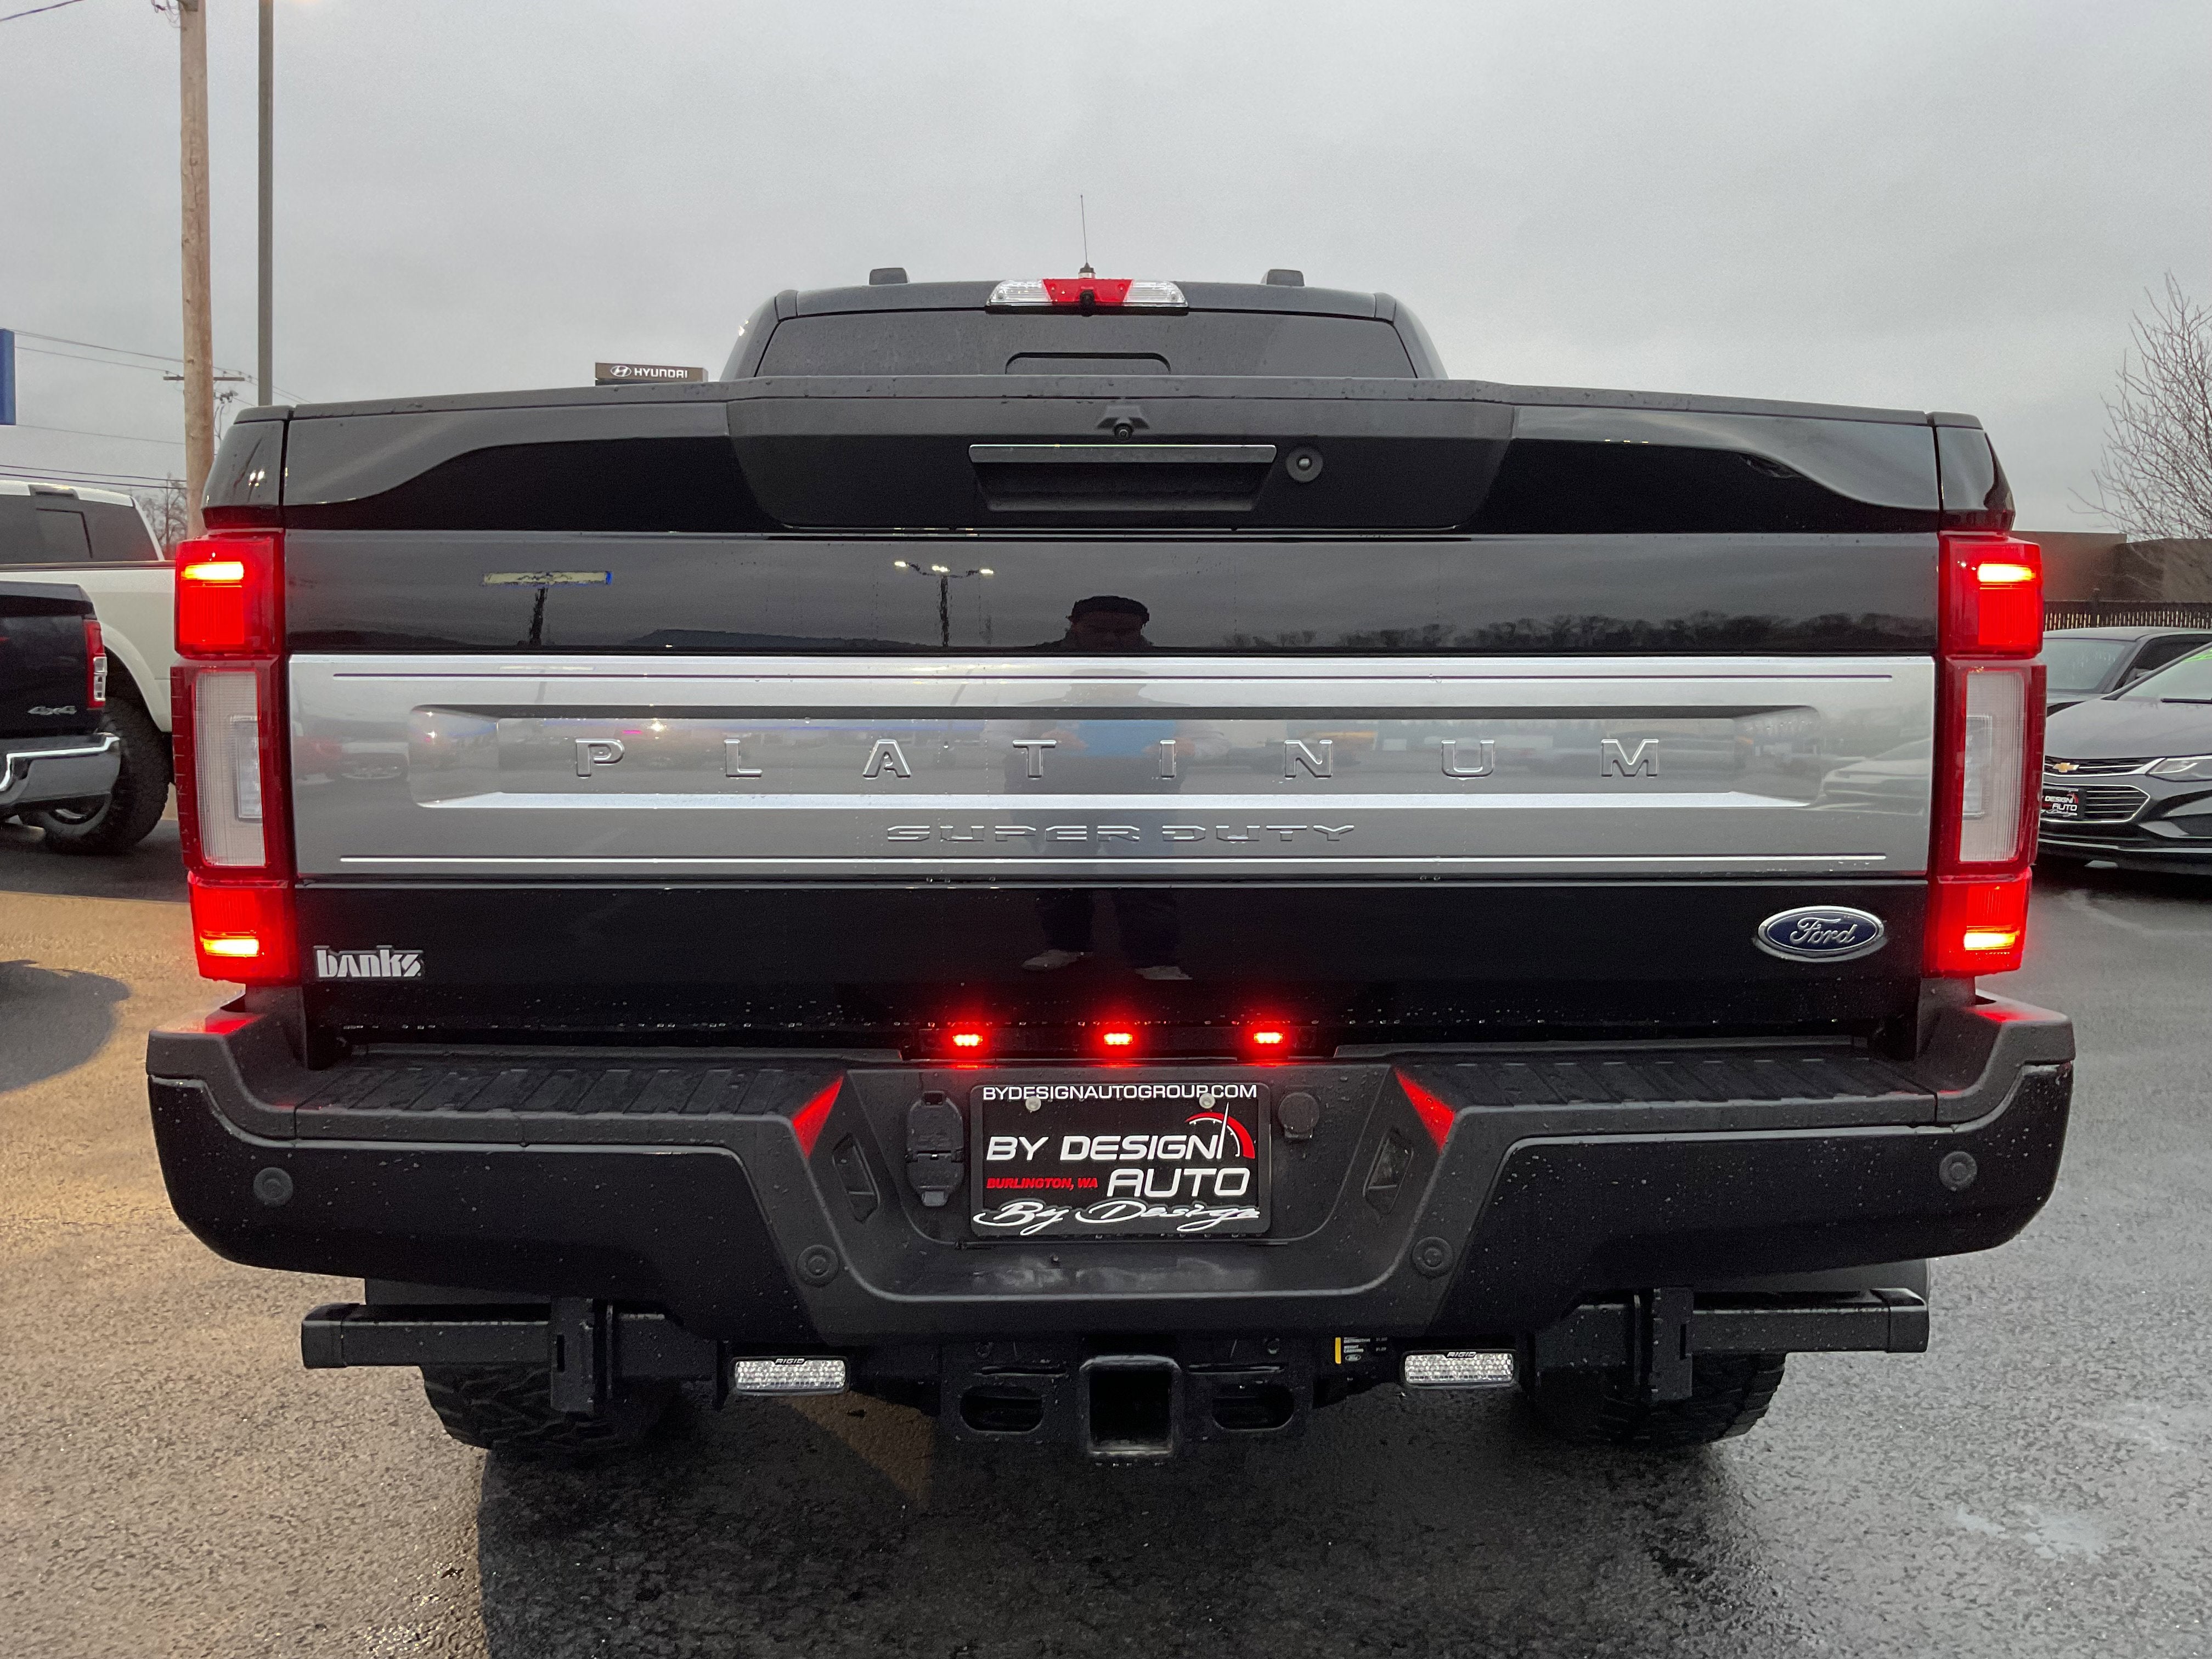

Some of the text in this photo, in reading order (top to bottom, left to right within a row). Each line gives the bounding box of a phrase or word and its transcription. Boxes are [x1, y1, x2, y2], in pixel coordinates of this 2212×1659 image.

[634, 367, 688, 379] HYUNDAI
[574, 737, 1660, 780] PLATINUM
[2045, 795, 2073, 804] DESIGN
[2052, 803, 2078, 811] AUTO
[887, 824, 1355, 843] SUPER DUTY
[1790, 916, 1858, 945] Ford
[983, 1085, 1257, 1100] BYDESIGNAUTOGROUPCOM
[986, 1136, 1219, 1161] BY DESIGN
[986, 1177, 1098, 1191] BURLINGTON, WA
[1107, 1167, 1250, 1197] AUTO
[973, 1200, 1260, 1236] By Design
